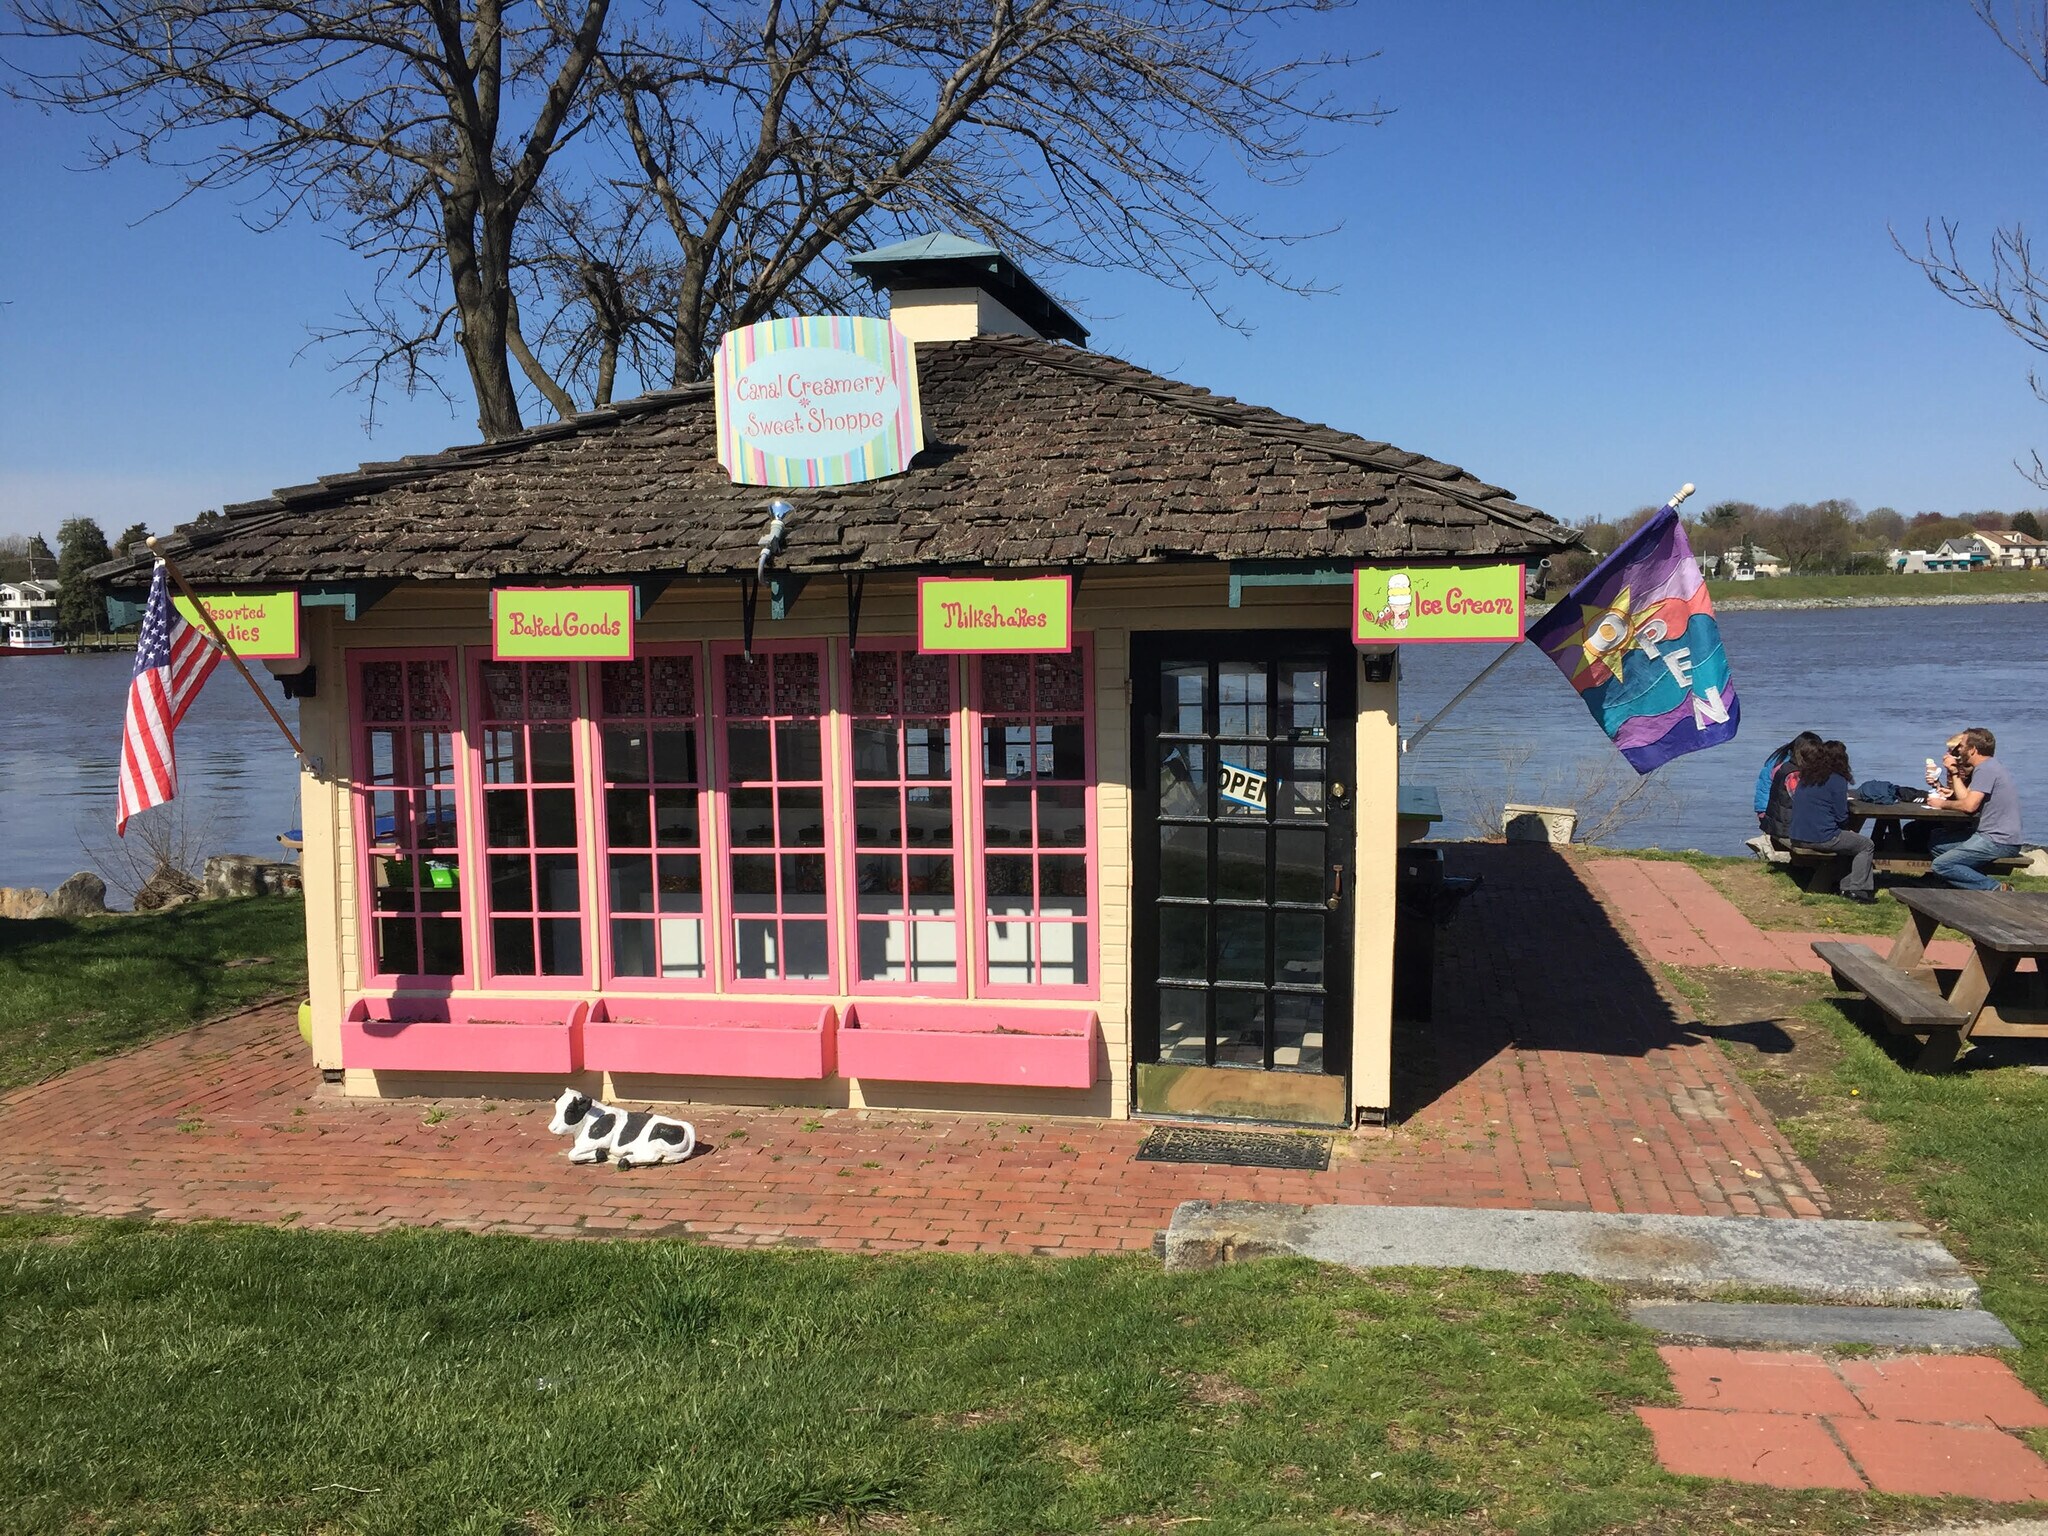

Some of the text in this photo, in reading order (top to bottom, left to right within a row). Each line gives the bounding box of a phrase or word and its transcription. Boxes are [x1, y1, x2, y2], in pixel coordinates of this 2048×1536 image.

[736, 373, 886, 401] Canal Creamery
[746, 407, 884, 437] Sweet Shoppe
[199, 601, 266, 621] Assorted
[941, 601, 1047, 629] Milkshakes
[1415, 587, 1514, 617] Ice Cream
[195, 623, 260, 642] dies
[1585, 613, 1731, 731] OPEN
